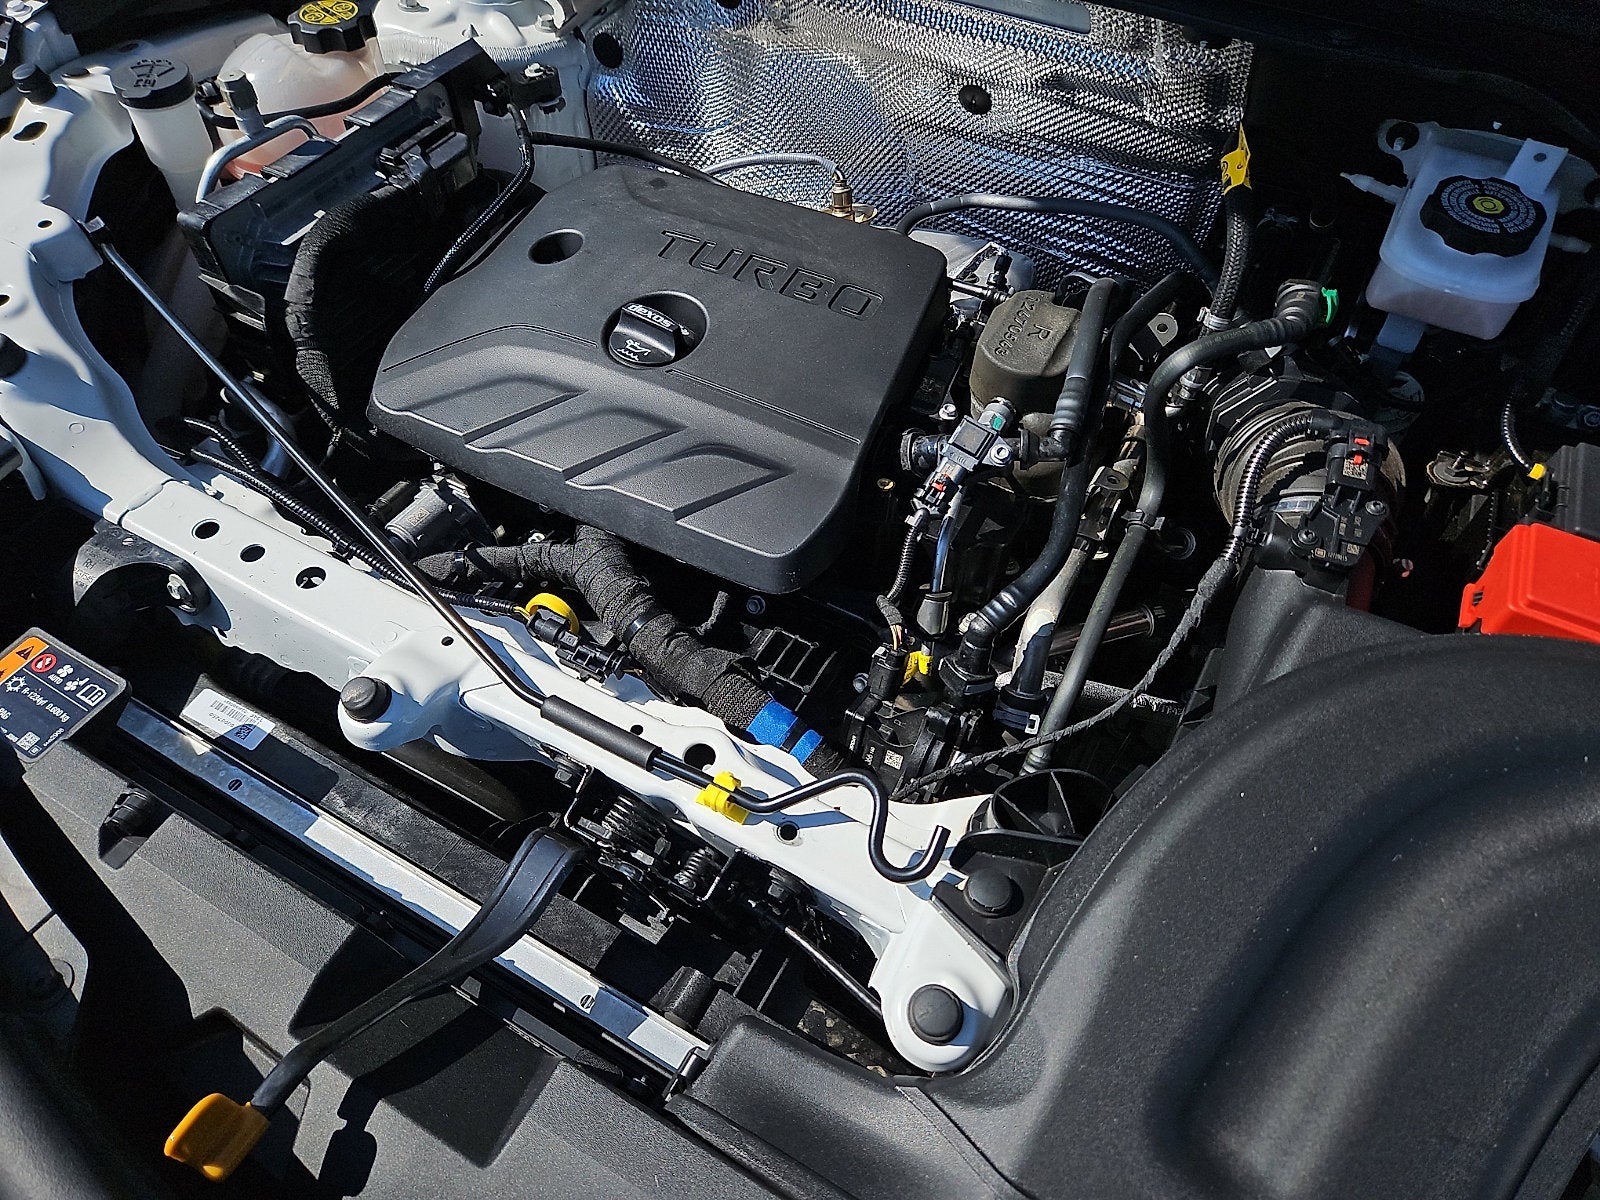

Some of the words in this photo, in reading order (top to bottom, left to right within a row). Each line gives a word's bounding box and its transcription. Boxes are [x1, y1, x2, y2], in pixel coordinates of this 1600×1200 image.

[657, 229, 884, 322] TURBO
[627, 304, 676, 328] dexos
[1027, 323, 1053, 340] R
[48, 674, 63, 685] AUTO
[60, 712, 71, 723] kg
